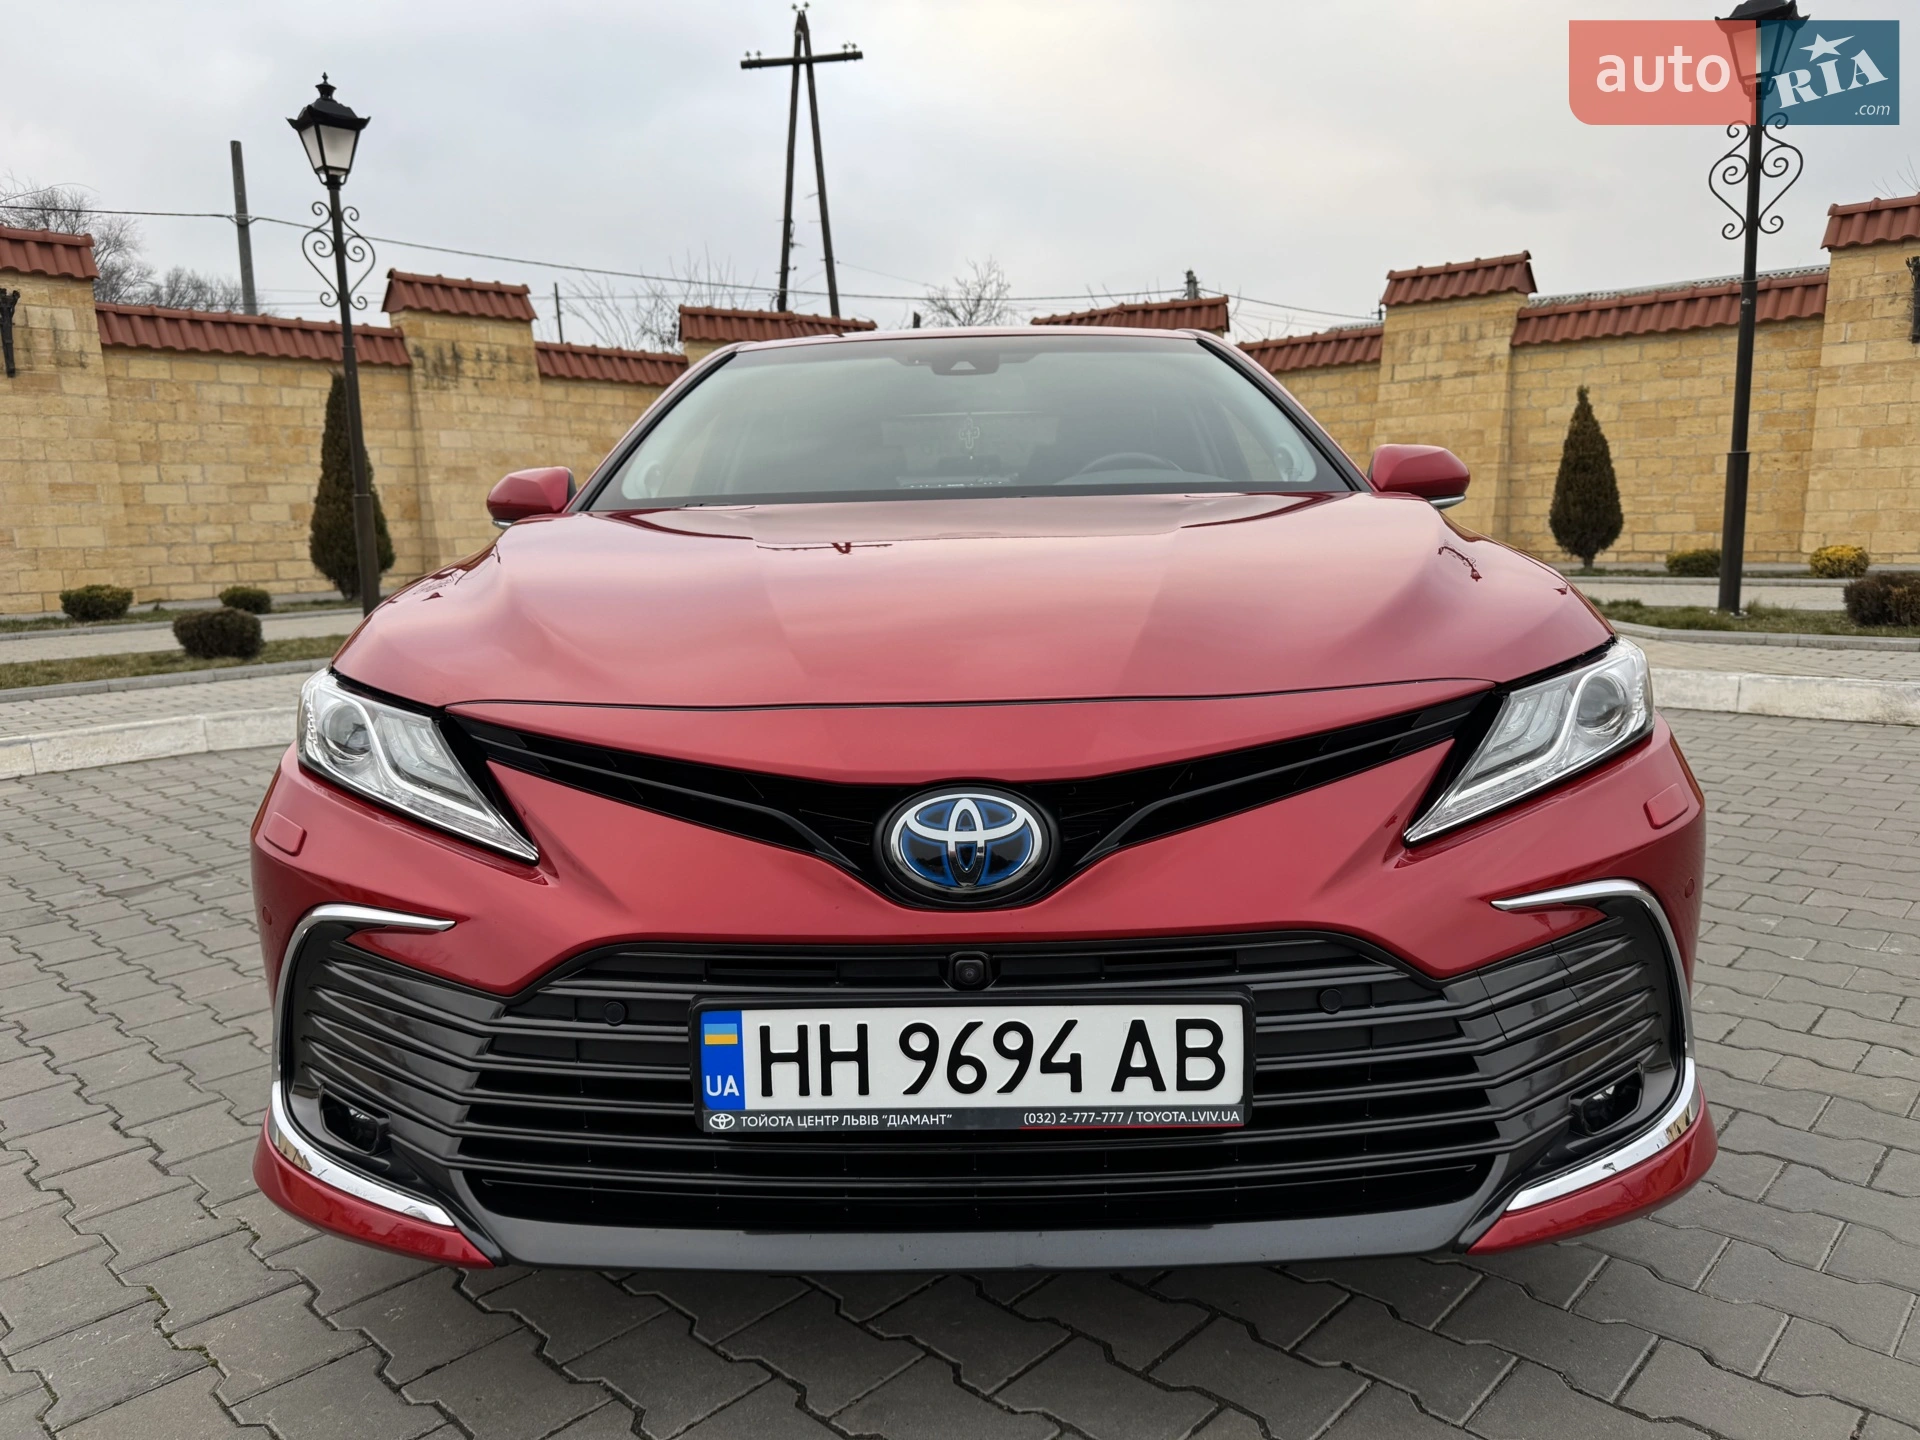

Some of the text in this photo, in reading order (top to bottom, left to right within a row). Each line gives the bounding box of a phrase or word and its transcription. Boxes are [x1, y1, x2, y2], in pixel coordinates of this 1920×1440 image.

[759, 1018, 1226, 1097] HH 9694 AB
[705, 1075, 740, 1097] UA
[740, 1113, 795, 1127] ТОЙОТА
[797, 1115, 840, 1128] ЦЕНТР
[841, 1114, 879, 1126] ЛЬВІВ
[1023, 1111, 1057, 1125] (032)
[1059, 1112, 1124, 1124] 2-777-777
[1136, 1111, 1240, 1123] TOYOTA.LVIV.UA
